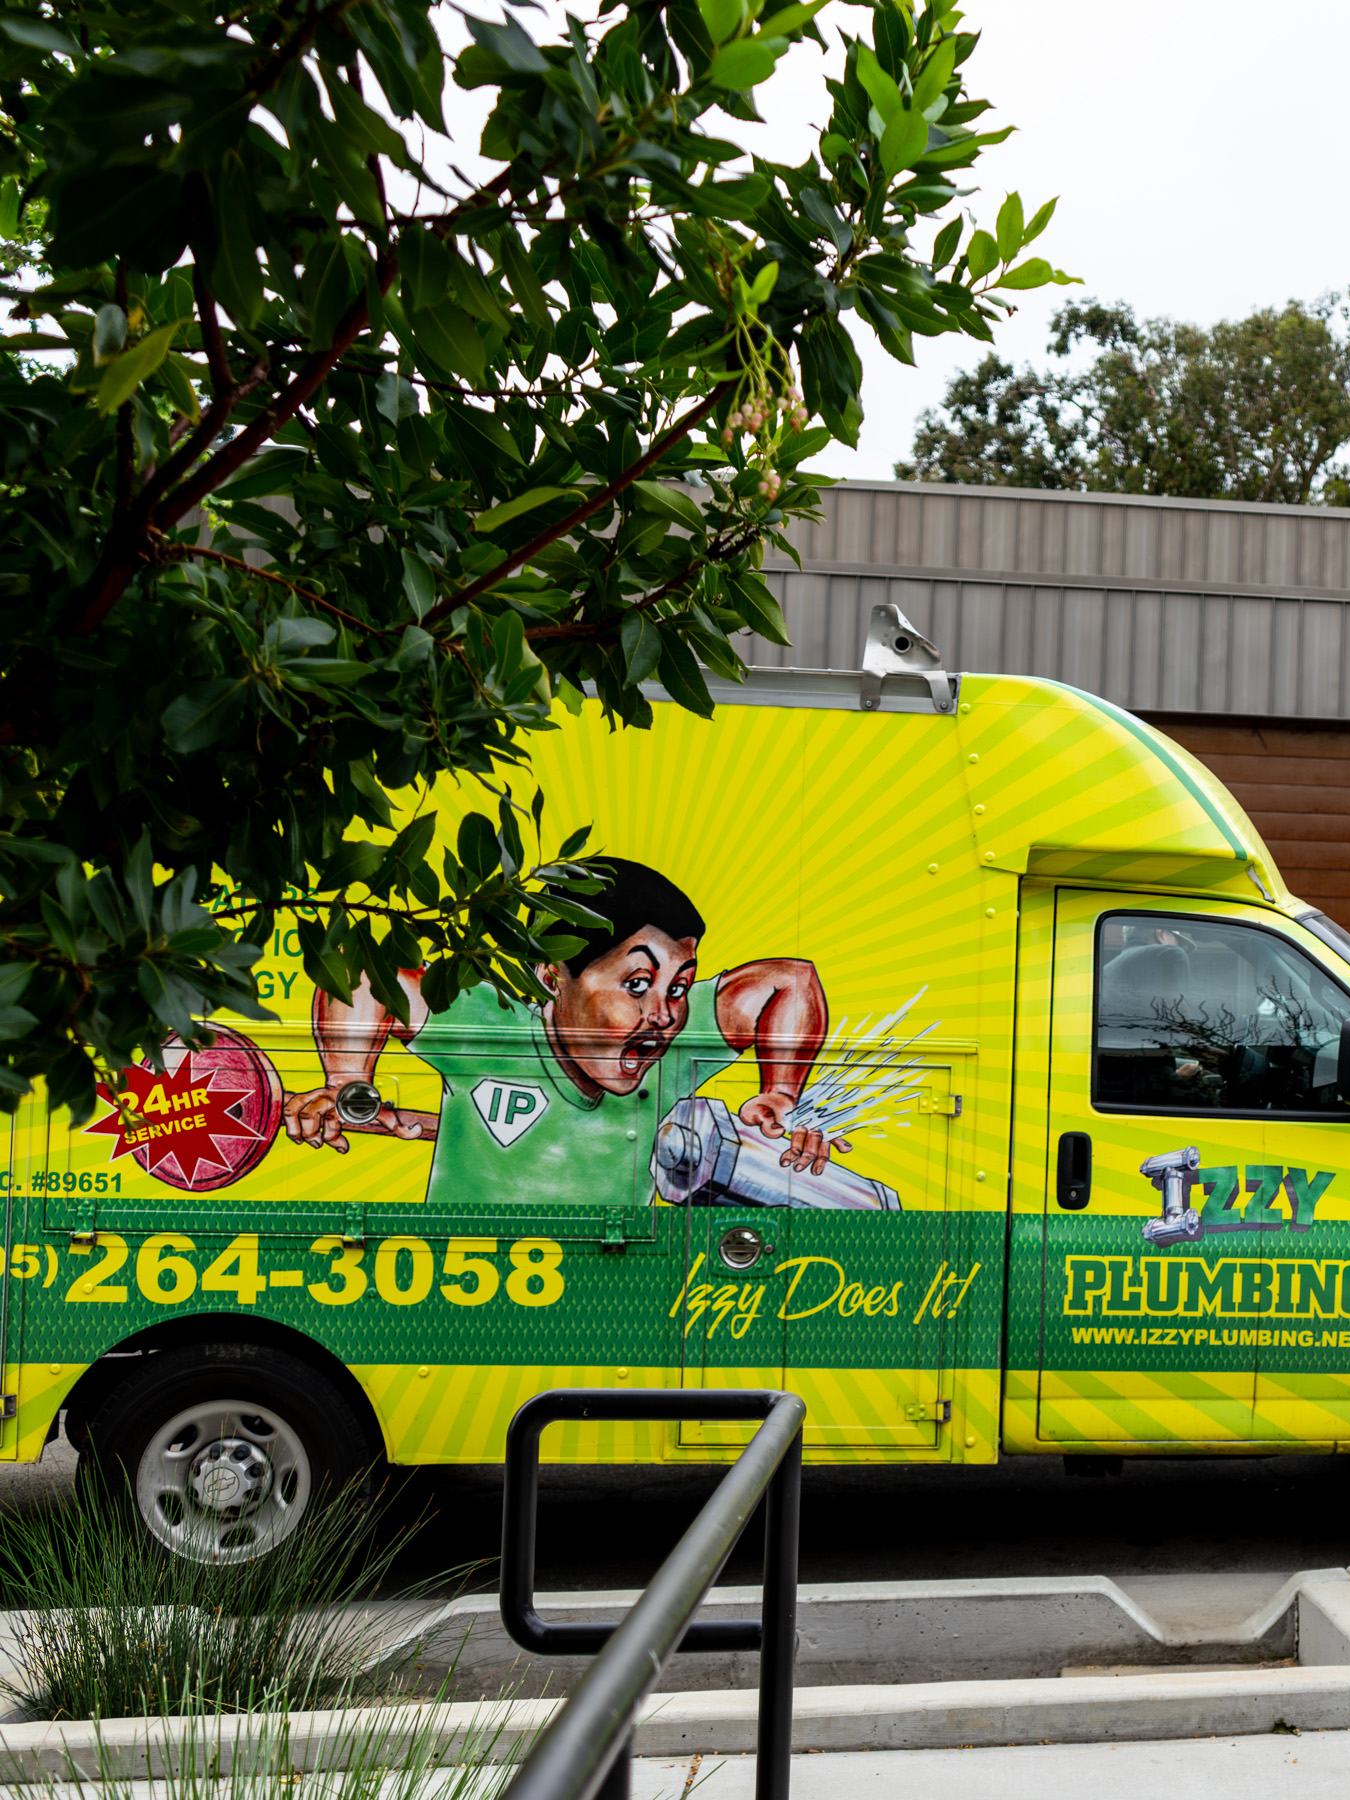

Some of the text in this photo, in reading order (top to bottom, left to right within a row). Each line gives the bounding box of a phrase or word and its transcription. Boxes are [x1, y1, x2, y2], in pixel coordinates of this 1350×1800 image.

[488, 1087, 537, 1126] IP
[124, 1114, 207, 1144] SERVICE
[31, 1171, 122, 1193] #89651
[1139, 1145, 1336, 1248] IZZY
[668, 1252, 982, 1340] Izzy Does It!
